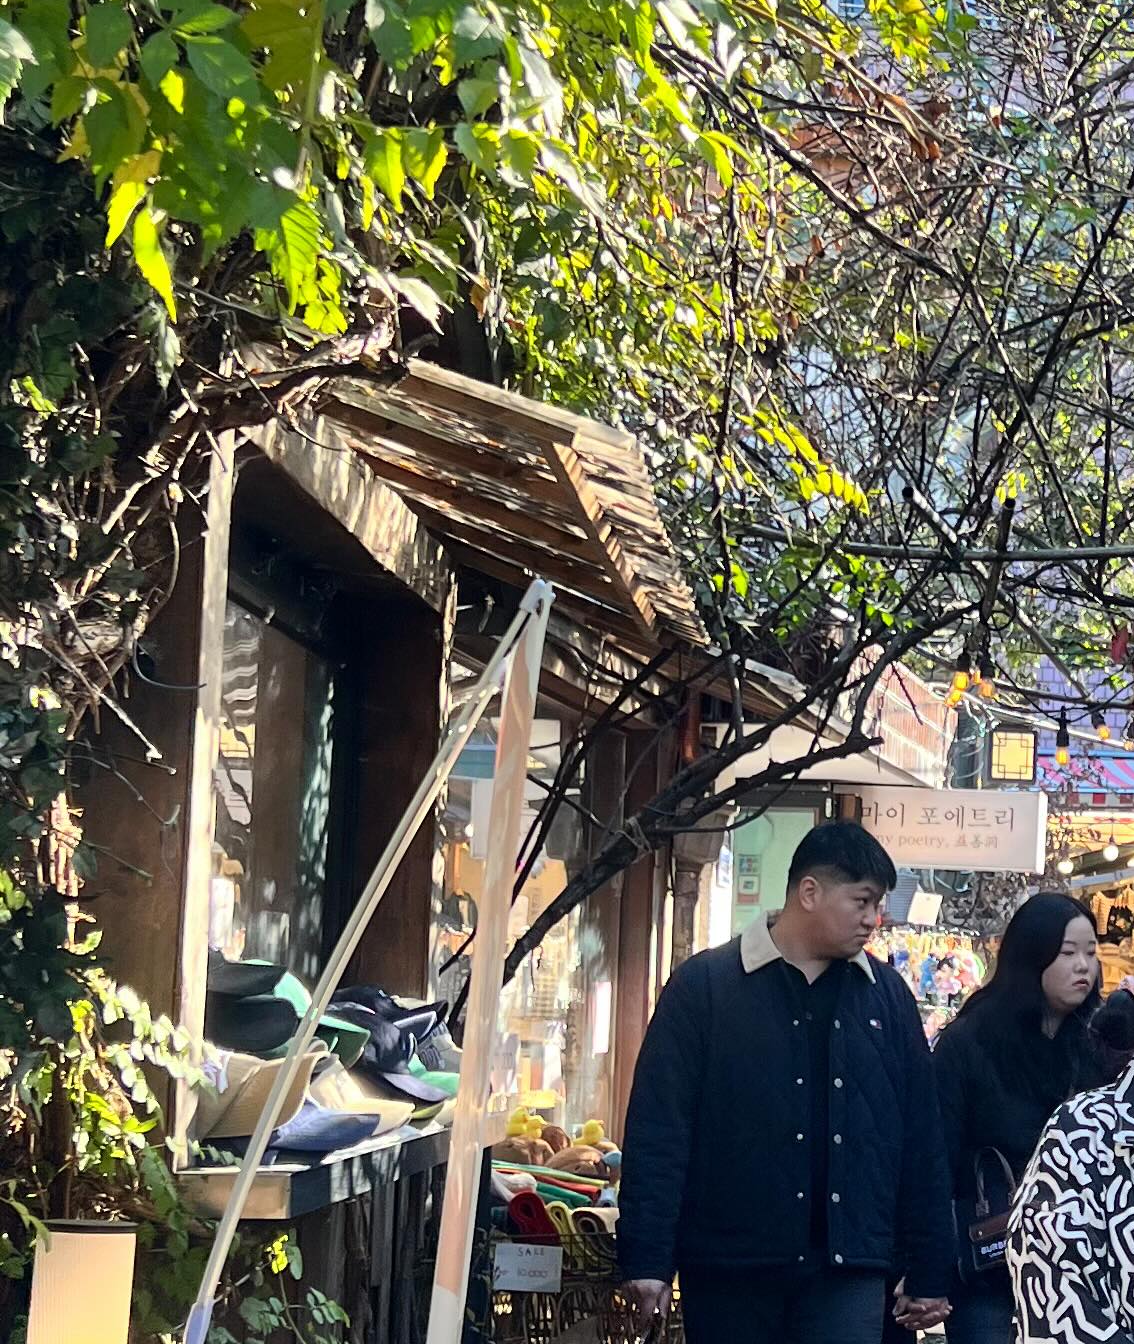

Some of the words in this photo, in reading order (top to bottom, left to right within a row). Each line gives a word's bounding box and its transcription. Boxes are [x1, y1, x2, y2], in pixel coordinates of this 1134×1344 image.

[862, 802, 906, 828] 마이
[916, 805, 1014, 832] 포에트리
[517, 1247, 545, 1257] SALE
